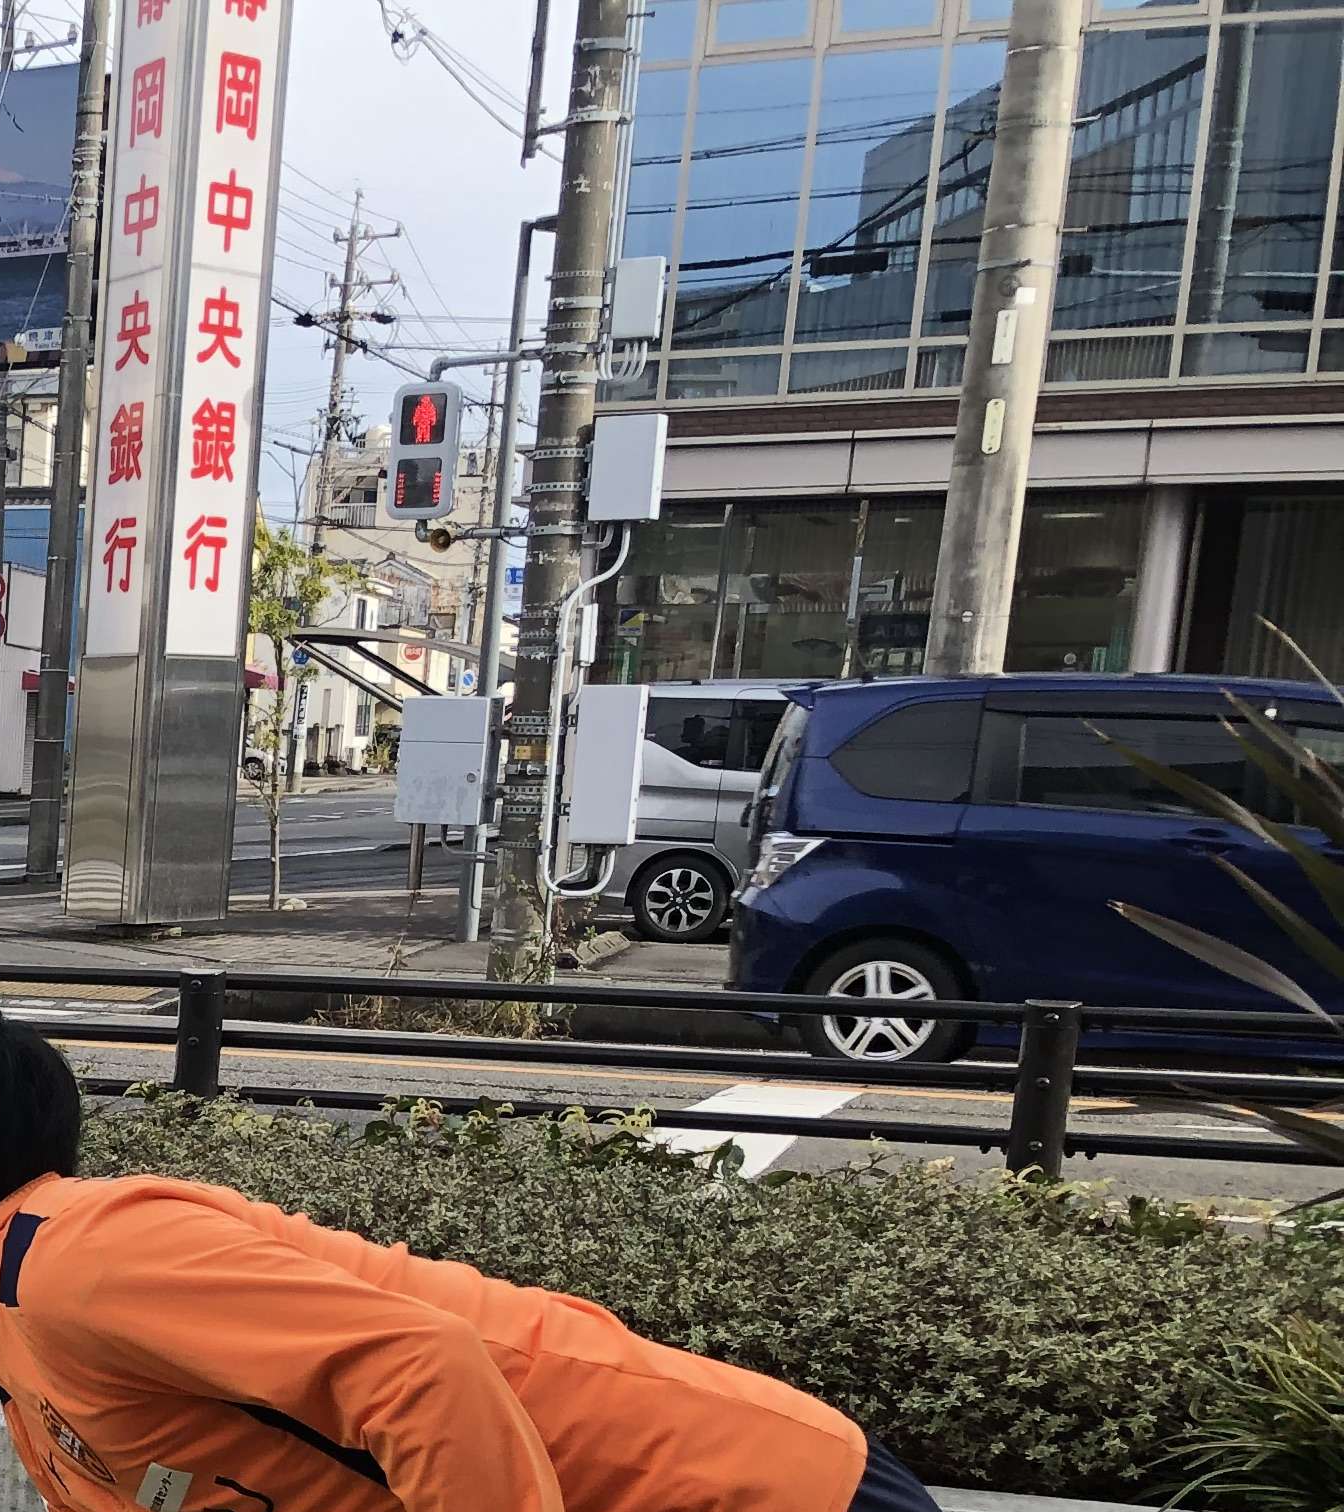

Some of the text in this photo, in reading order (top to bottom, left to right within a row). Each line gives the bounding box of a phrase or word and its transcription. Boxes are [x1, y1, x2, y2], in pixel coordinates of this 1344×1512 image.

[184, 0, 267, 593] 岡中央銀行
